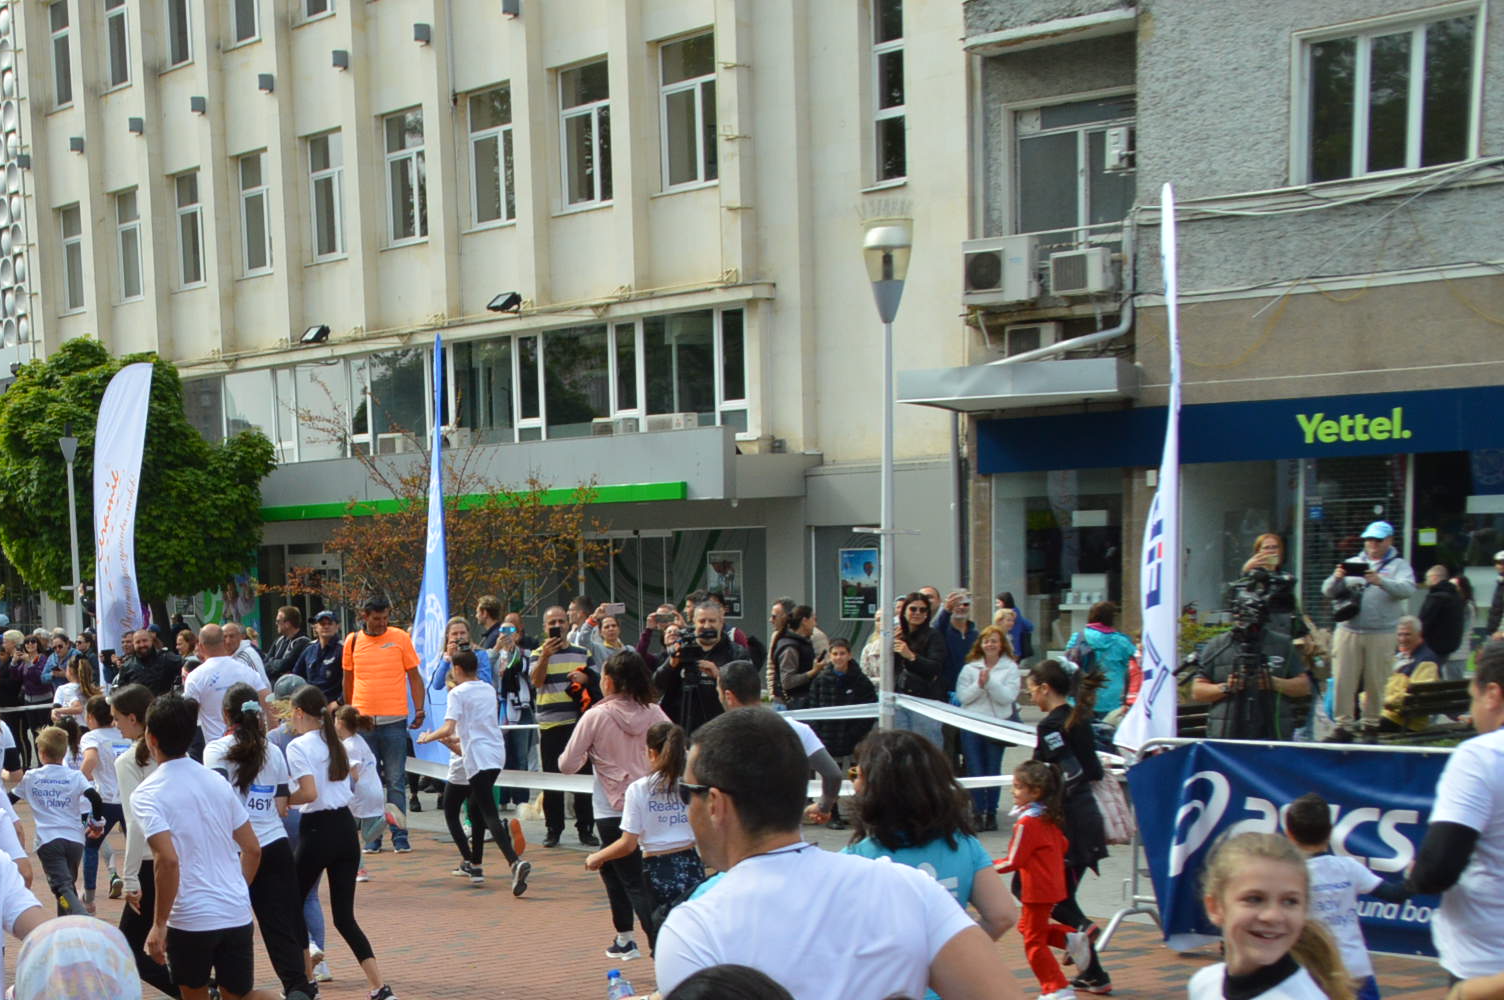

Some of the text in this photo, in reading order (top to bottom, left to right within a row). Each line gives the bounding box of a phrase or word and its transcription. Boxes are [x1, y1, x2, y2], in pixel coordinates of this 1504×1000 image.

[32, 787, 61, 798] Ready
[649, 801, 687, 813] Ready
[669, 813, 689, 826] pla
